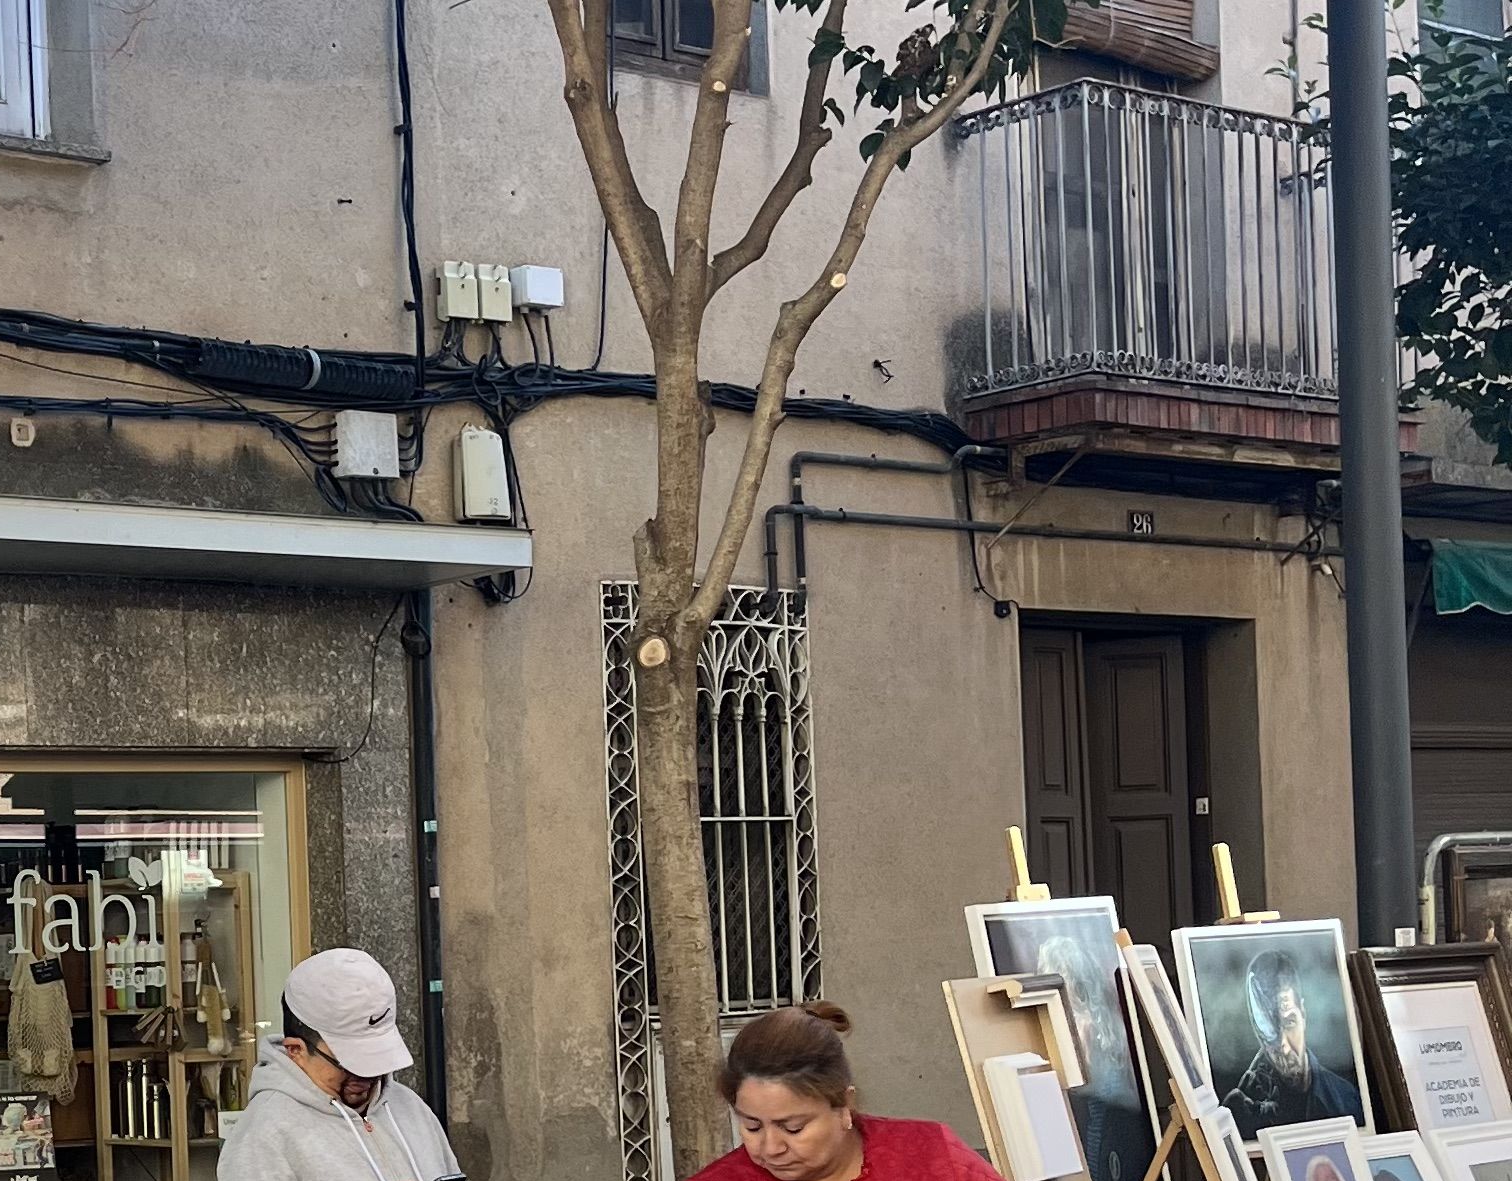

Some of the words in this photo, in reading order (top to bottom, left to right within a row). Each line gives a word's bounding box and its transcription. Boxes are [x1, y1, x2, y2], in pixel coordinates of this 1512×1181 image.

[1133, 513, 1152, 535] 26
[6, 868, 160, 954] fabi
[1425, 1078, 1468, 1092] ACADEMIA
[1469, 1076, 1481, 1088] DE
[1438, 1092, 1467, 1105] DIBUJO
[1440, 1105, 1480, 1118] PINTURA
